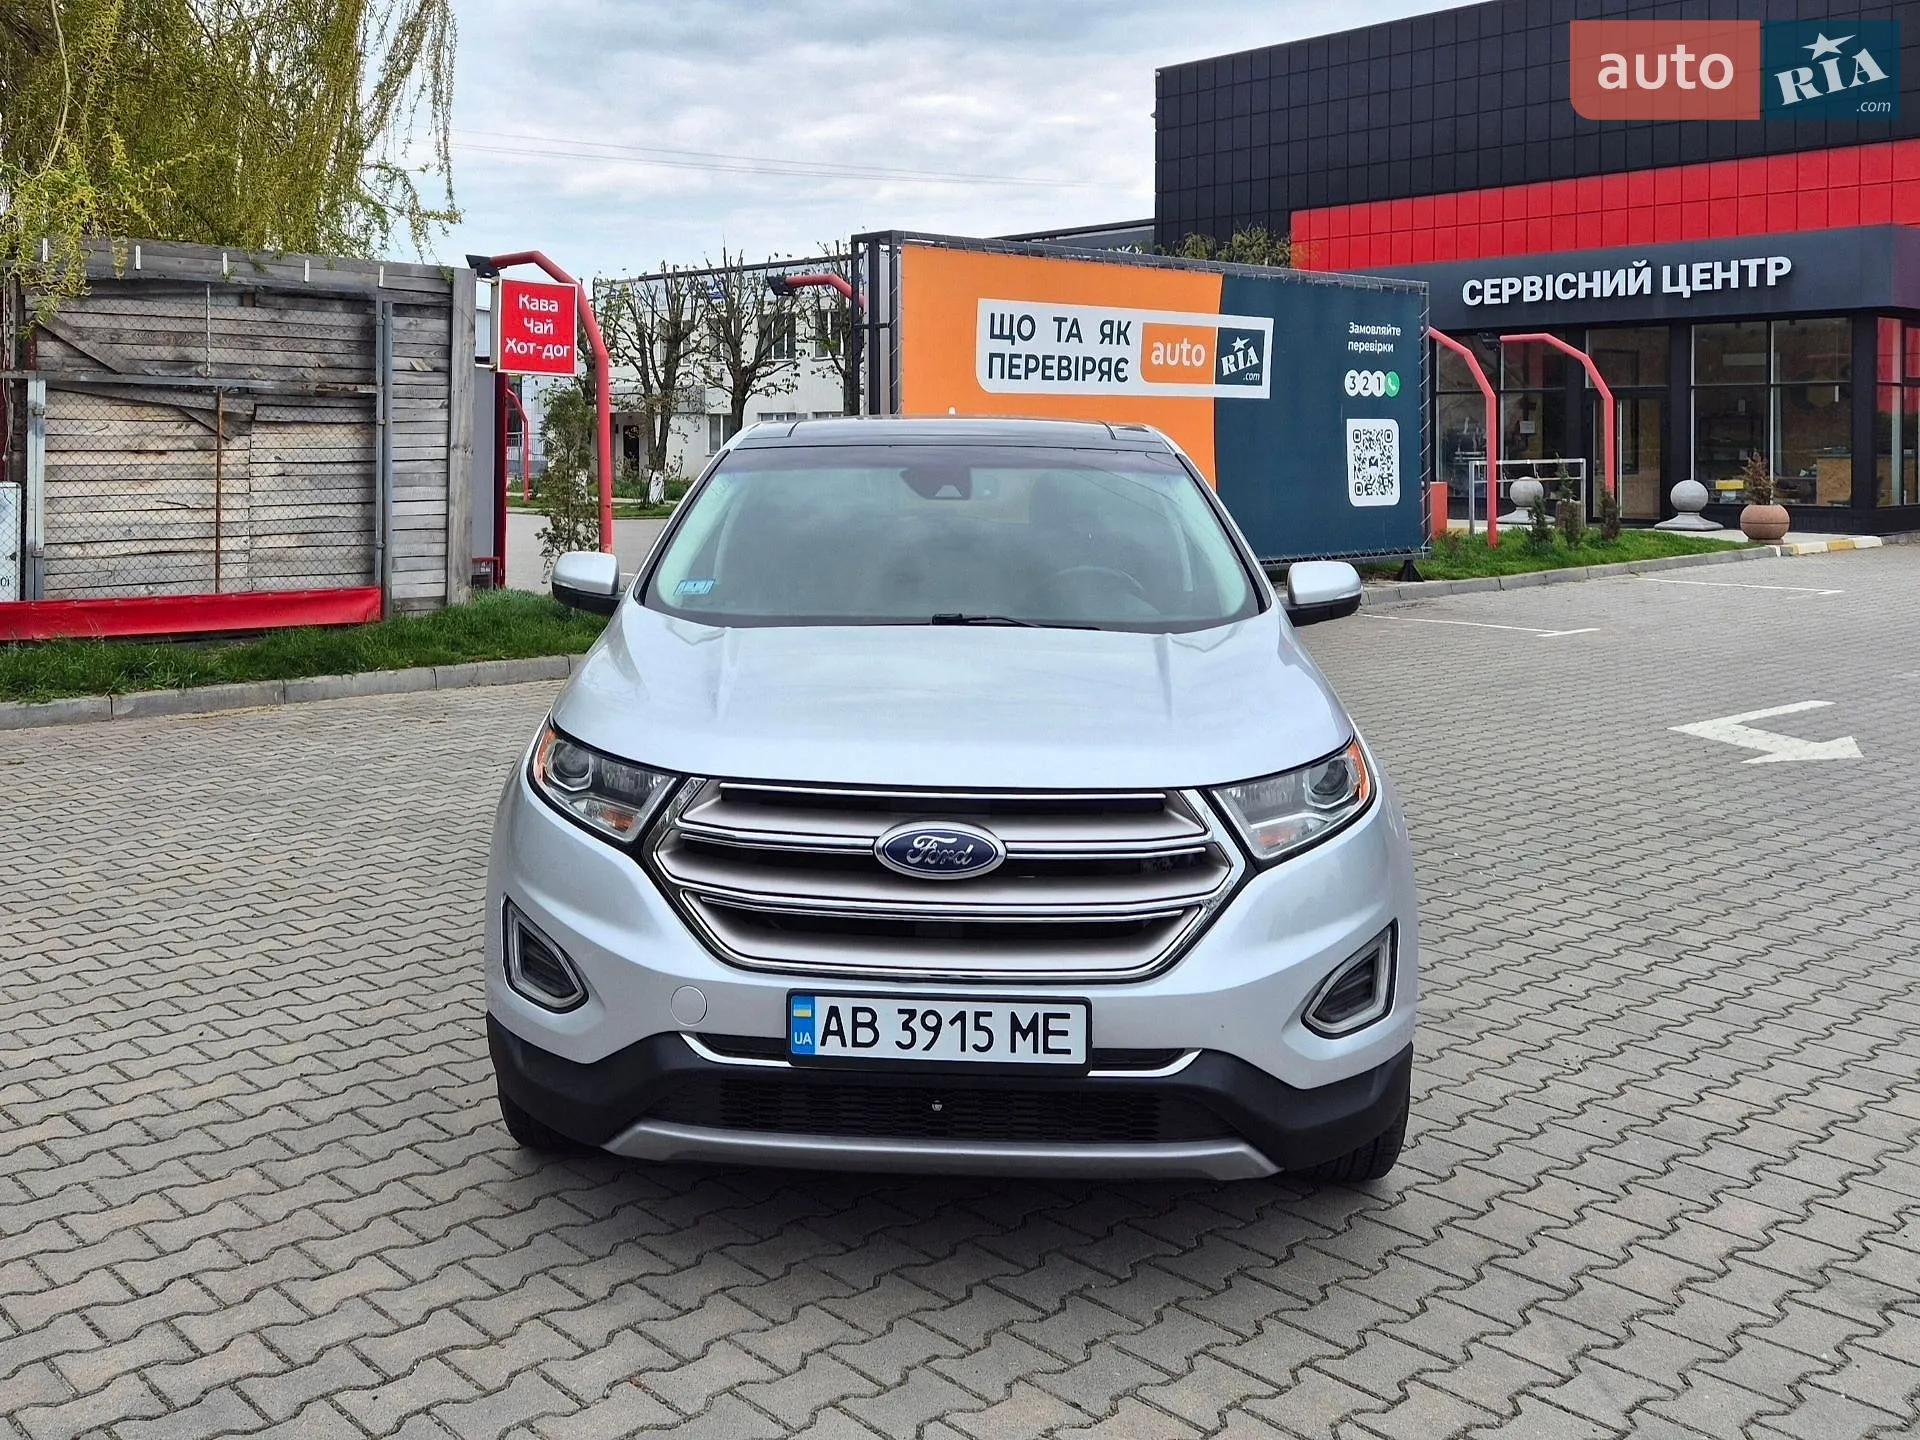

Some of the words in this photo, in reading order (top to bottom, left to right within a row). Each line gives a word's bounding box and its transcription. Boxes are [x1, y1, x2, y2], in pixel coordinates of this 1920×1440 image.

[1462, 259, 1652, 306] СЕРВІСНИЙ
[1662, 256, 1792, 298] ЦЕНТР
[518, 293, 559, 312] Кава
[523, 317, 554, 335] Чай
[989, 312, 1036, 345] ЩО
[1053, 316, 1083, 343] ТА
[1099, 319, 1132, 345] ЯК
[1348, 321, 1402, 337] Замовляйте
[504, 336, 571, 360] Хот-дог
[1150, 337, 1207, 367] auto
[1221, 345, 1260, 377] RIA
[1347, 339, 1395, 355] перевірки
[988, 352, 1130, 383] ПЕРЕВІРЯЄ
[1242, 372, 1260, 381] .com
[906, 834, 975, 865] Ford
[794, 1031, 813, 1046] UA
[819, 1005, 880, 1049] AB
[895, 1008, 995, 1053] 3915
[1009, 1011, 1072, 1055] ME
